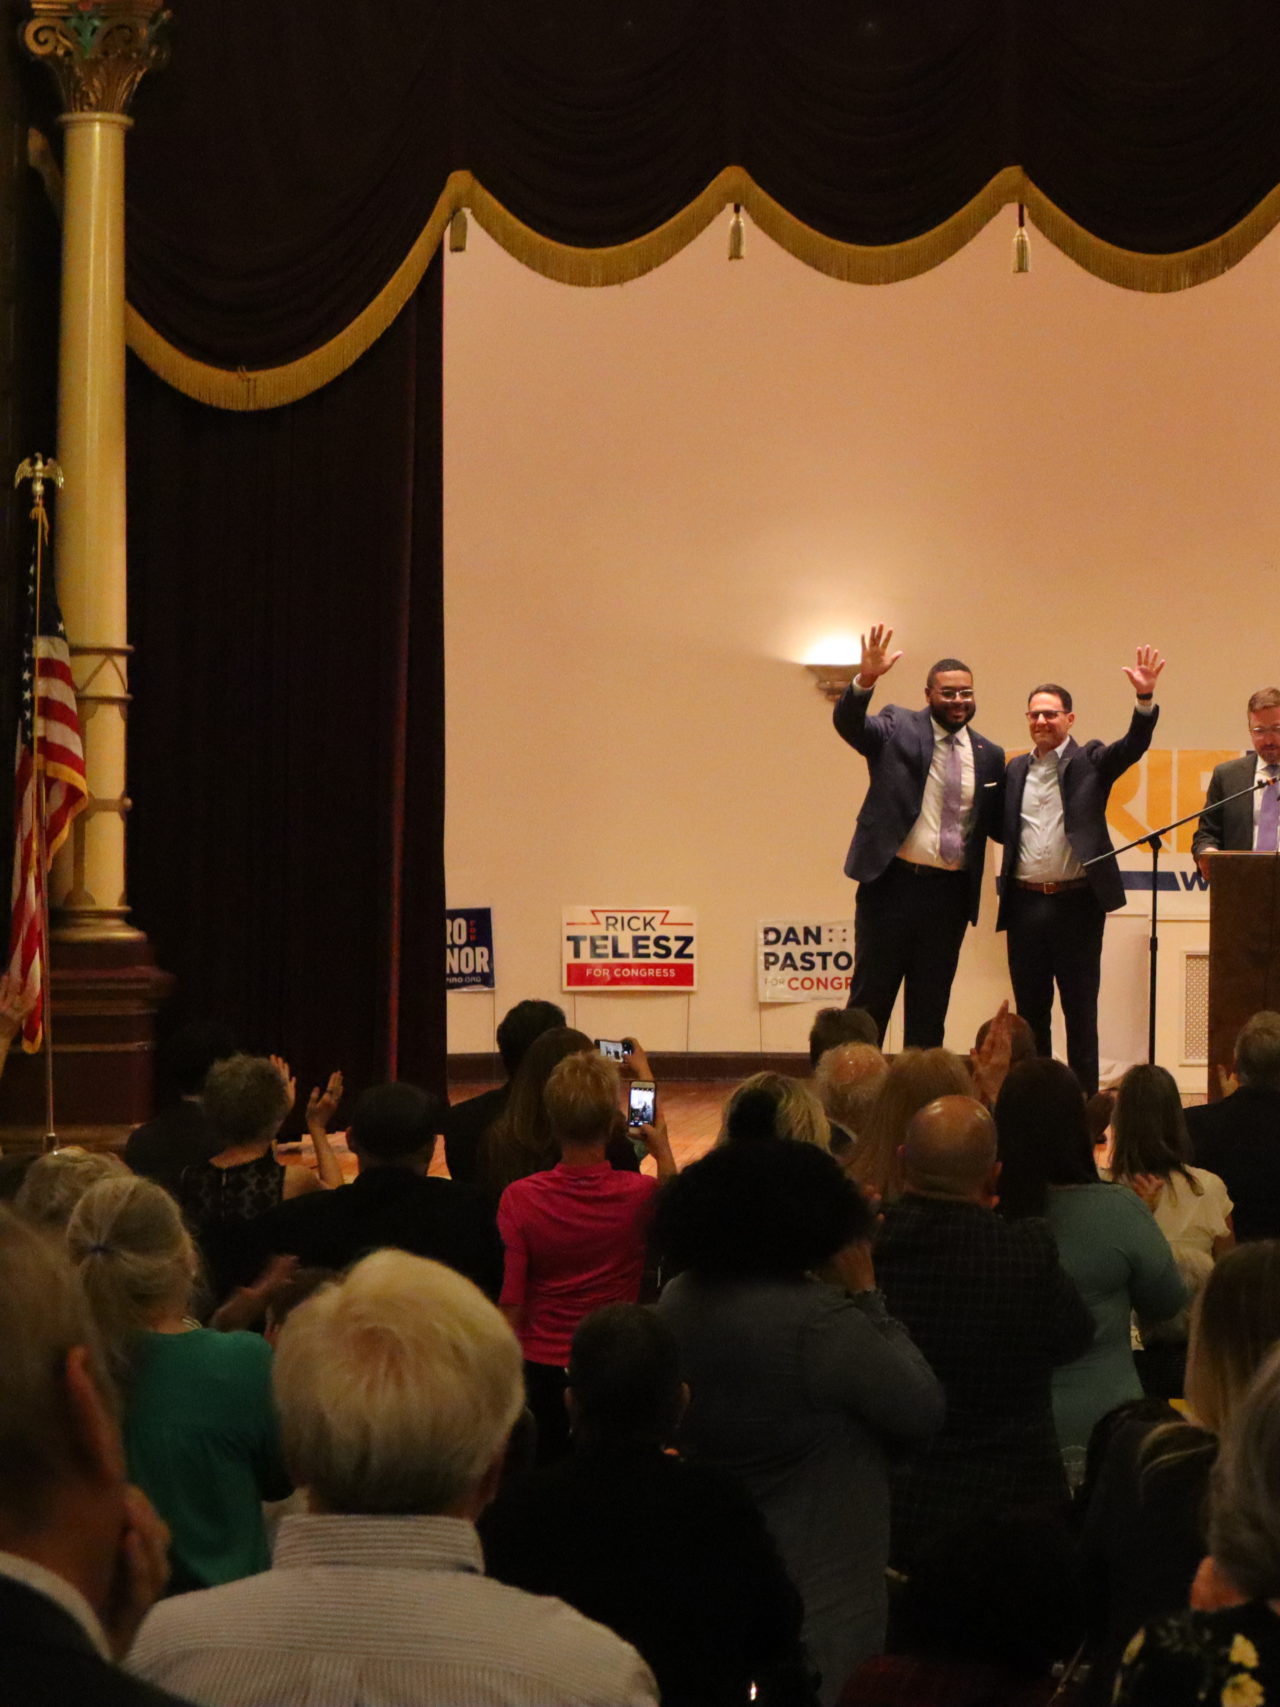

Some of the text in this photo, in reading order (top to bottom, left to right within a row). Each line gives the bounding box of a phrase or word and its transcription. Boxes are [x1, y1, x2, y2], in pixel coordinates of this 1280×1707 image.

[605, 915, 656, 931] RICK
[763, 926, 822, 946] DAN
[566, 935, 694, 959] TELESZ
[586, 968, 676, 977] FOR CONGRESS
[764, 978, 785, 986] FOR
